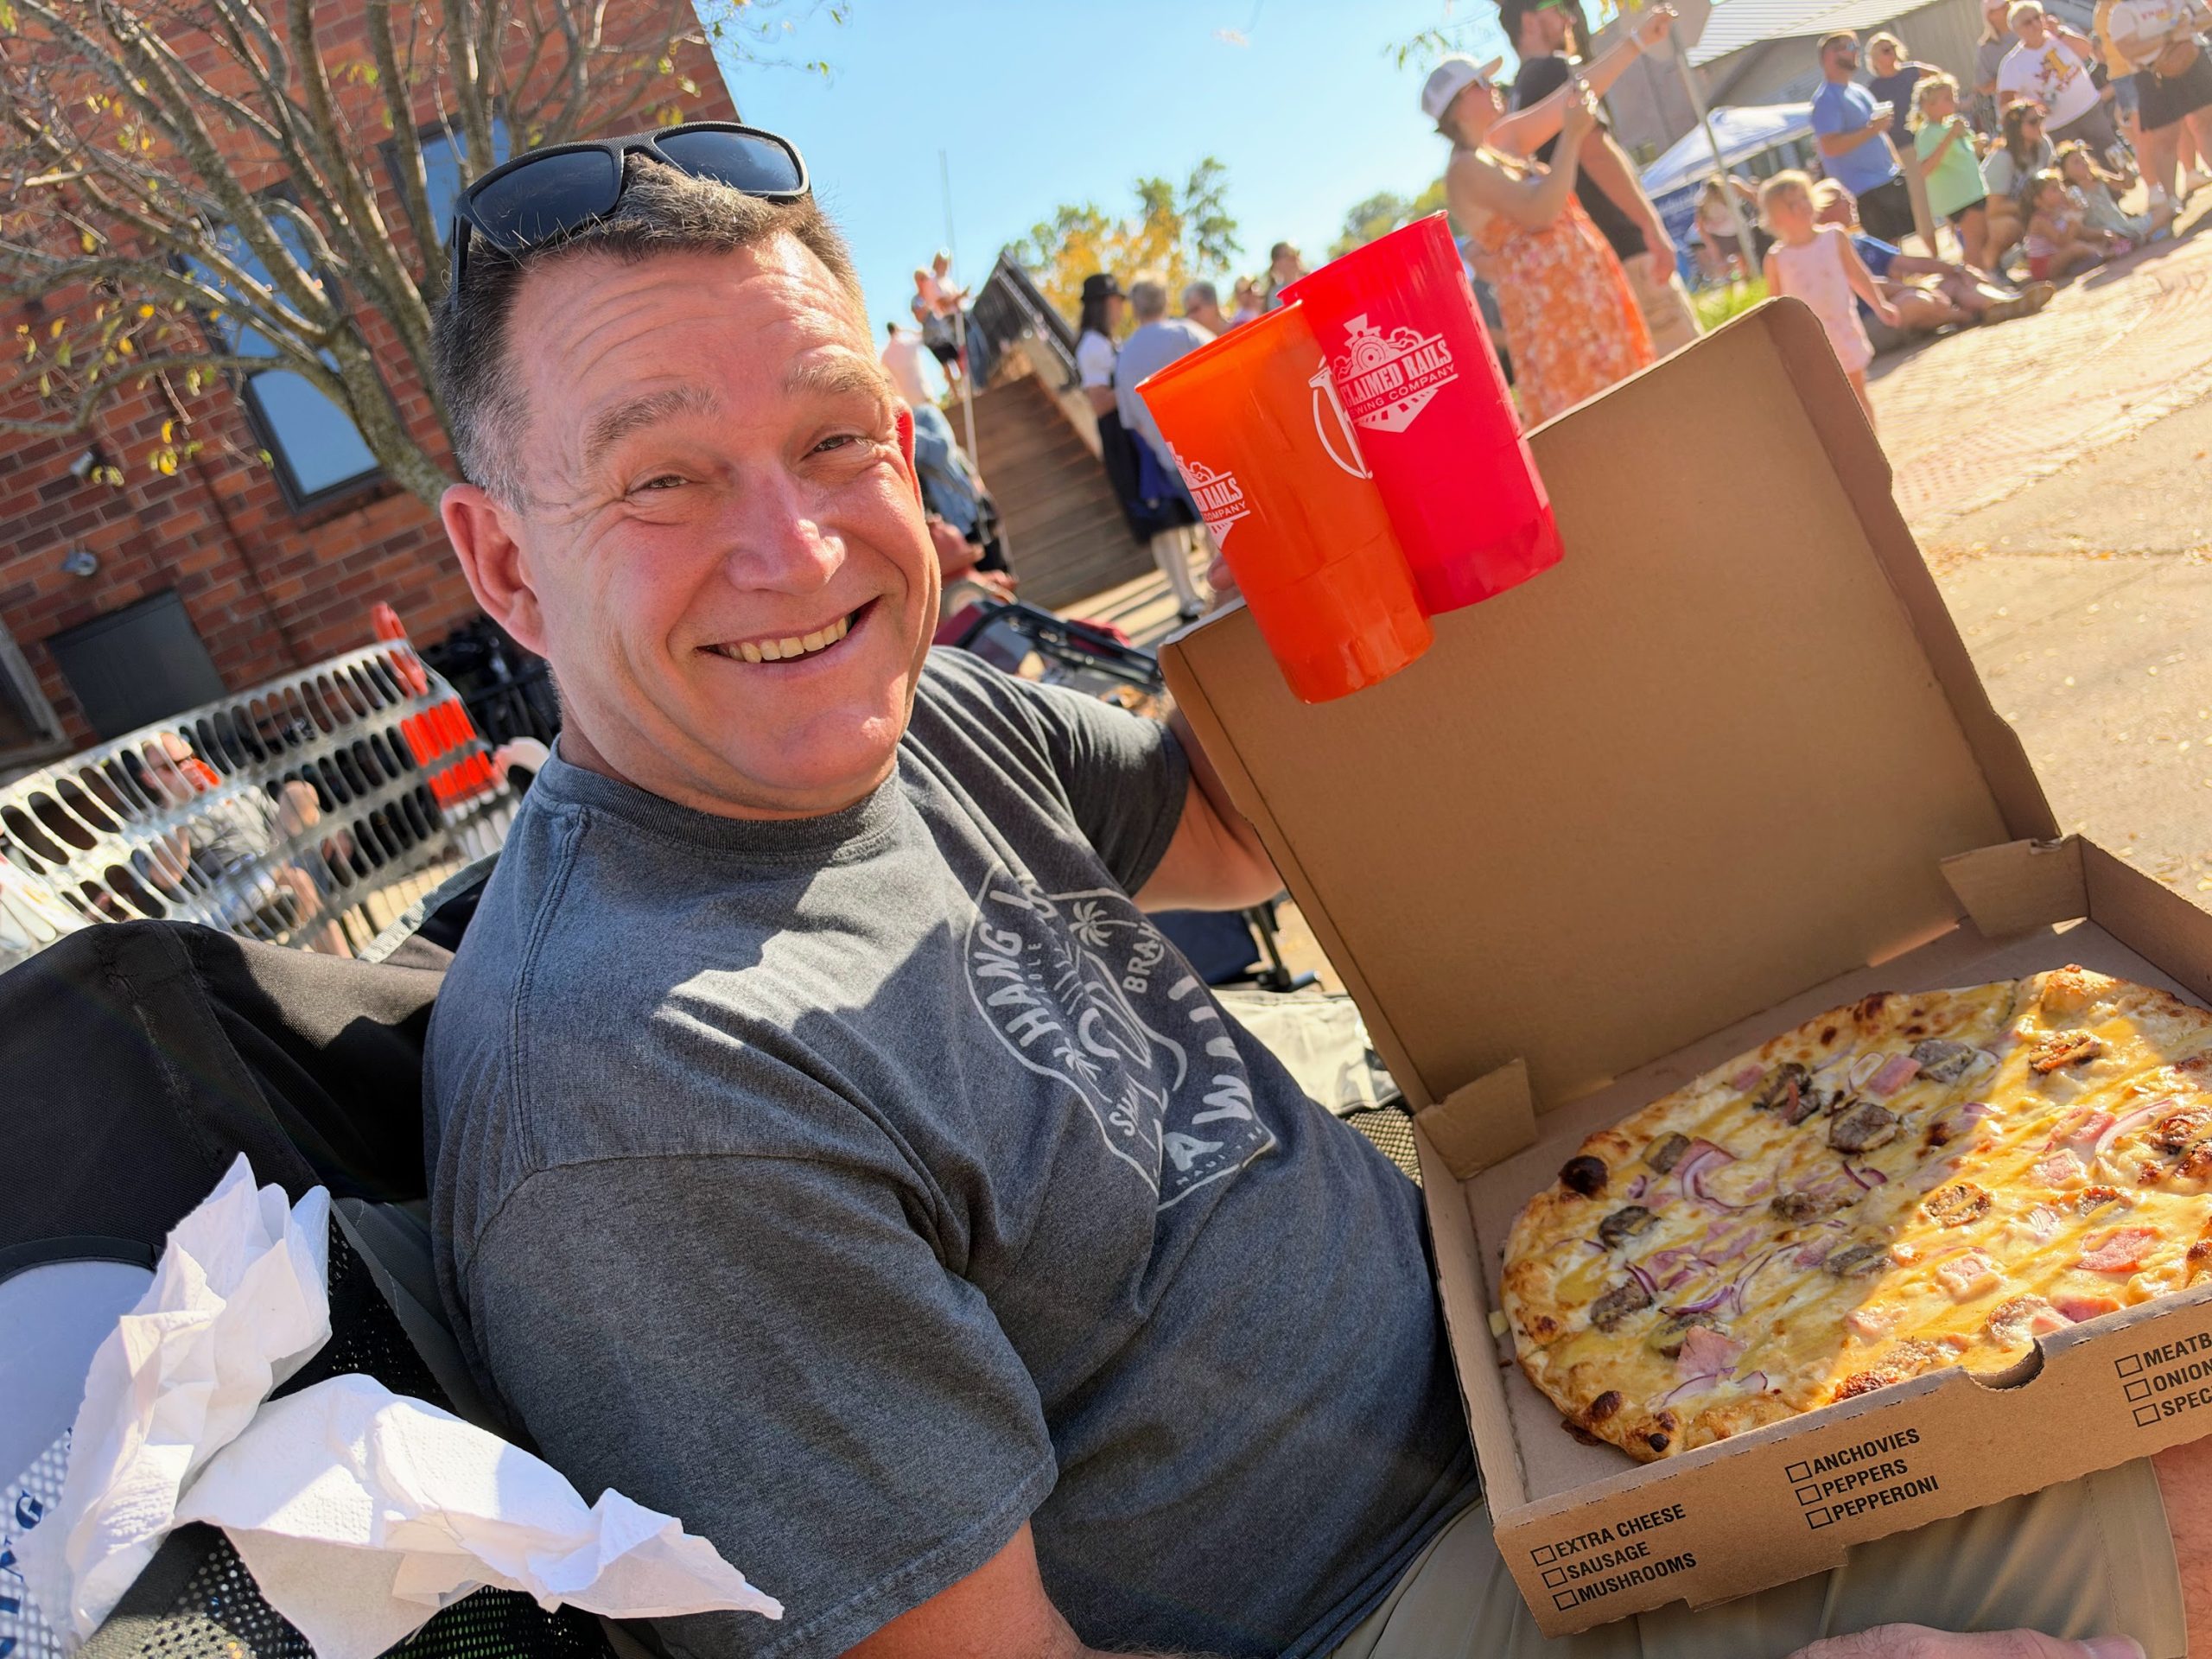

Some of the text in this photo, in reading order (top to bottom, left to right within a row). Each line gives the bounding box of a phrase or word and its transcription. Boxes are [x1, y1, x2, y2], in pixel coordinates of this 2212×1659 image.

[1339, 340, 1453, 408] CLAIMED RAILS
[1350, 364, 1455, 417] EWING COMPANY
[1201, 477, 1243, 510] RAILS
[973, 922, 1063, 1047] HANG
[2161, 1386, 2212, 1417] SPEC
[1814, 1428, 1920, 1474] ANCHOVIES
[1822, 1459, 1908, 1497] PEPPERS
[1832, 1475, 1939, 1521] PEPPERONI
[1554, 1503, 1686, 1557] EXTRA CHEESE
[1567, 1541, 1651, 1580] SAUSAGE
[1578, 1553, 1697, 1602] MUSHROOMS
